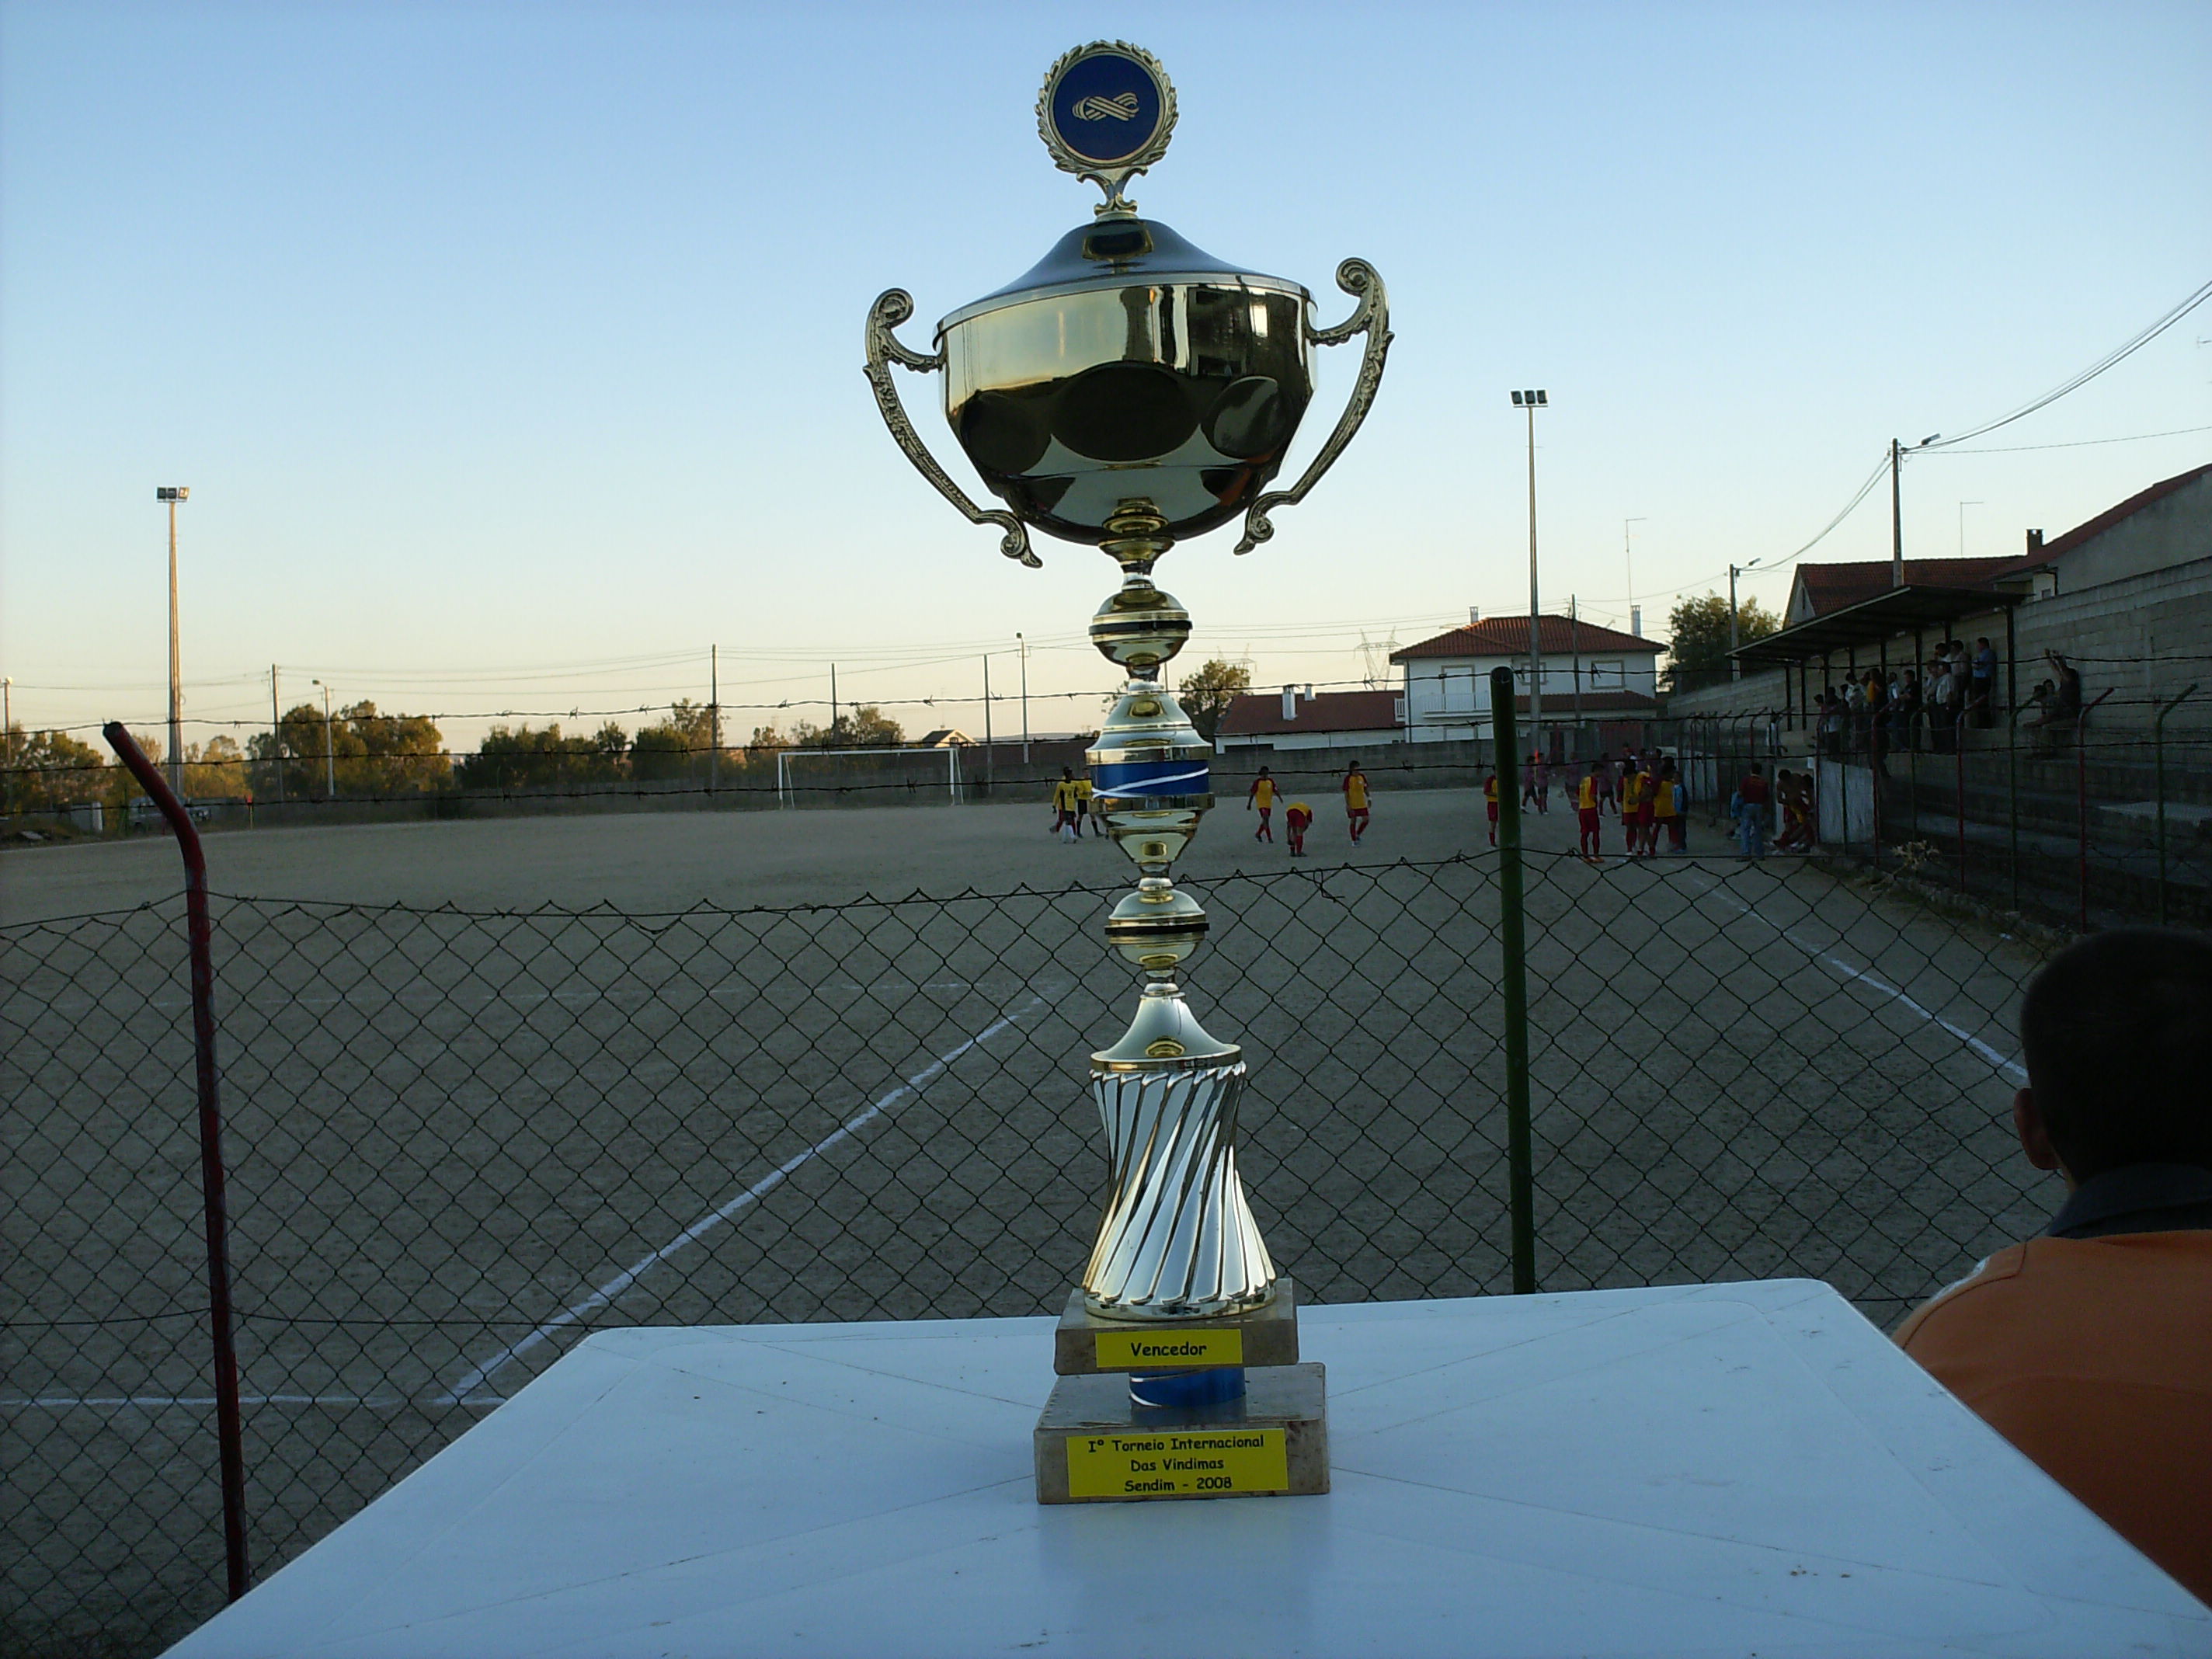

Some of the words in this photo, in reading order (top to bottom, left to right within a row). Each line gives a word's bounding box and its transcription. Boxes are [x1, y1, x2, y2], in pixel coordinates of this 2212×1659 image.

[1130, 1341, 1208, 1358] Vencedor
[1111, 1438, 1165, 1452] Torneio
[1170, 1435, 1264, 1451] Internacional
[1131, 1459, 1157, 1473] Das
[1162, 1456, 1225, 1472] Vindimas
[1124, 1478, 1176, 1493] Sendim
[1196, 1476, 1233, 1490] 2008
